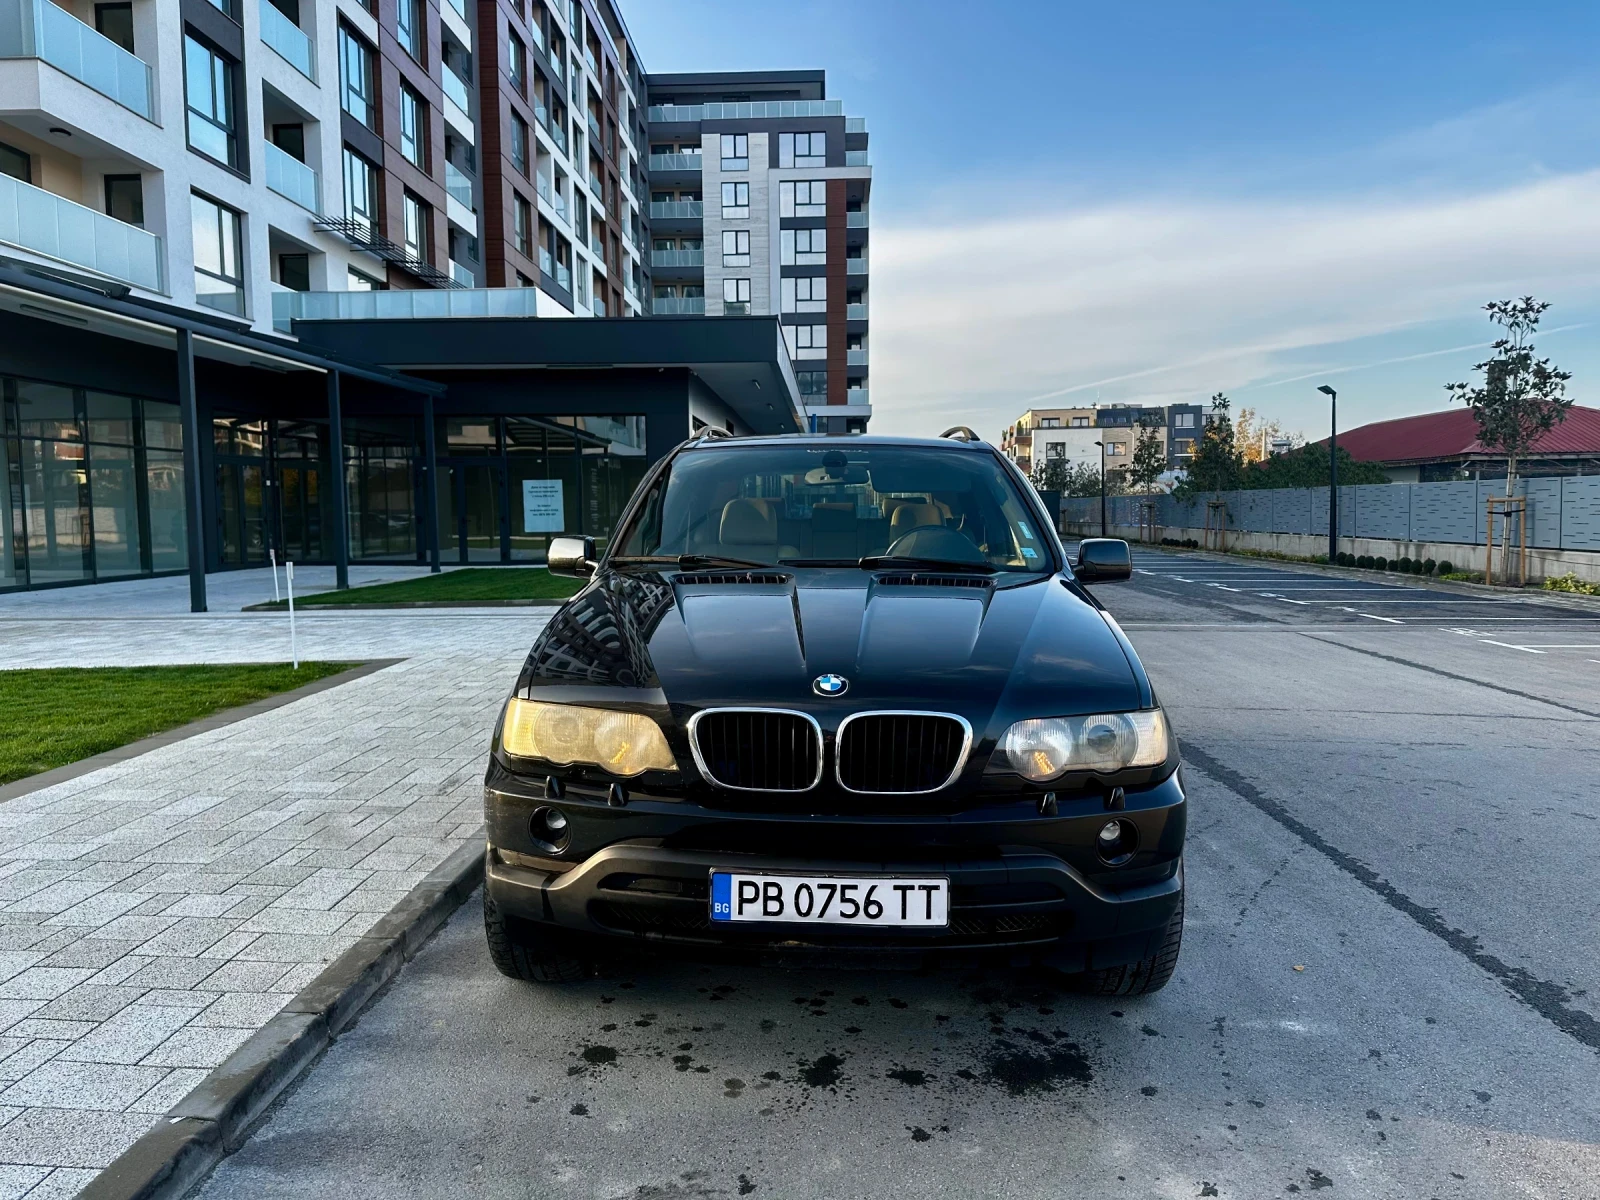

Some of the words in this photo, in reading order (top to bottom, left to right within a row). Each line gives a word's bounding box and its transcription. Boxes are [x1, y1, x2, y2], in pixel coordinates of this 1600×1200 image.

[714, 903, 729, 914] BG
[737, 880, 785, 917] PB
[793, 883, 884, 920] 0756
[893, 884, 941, 920] TT
